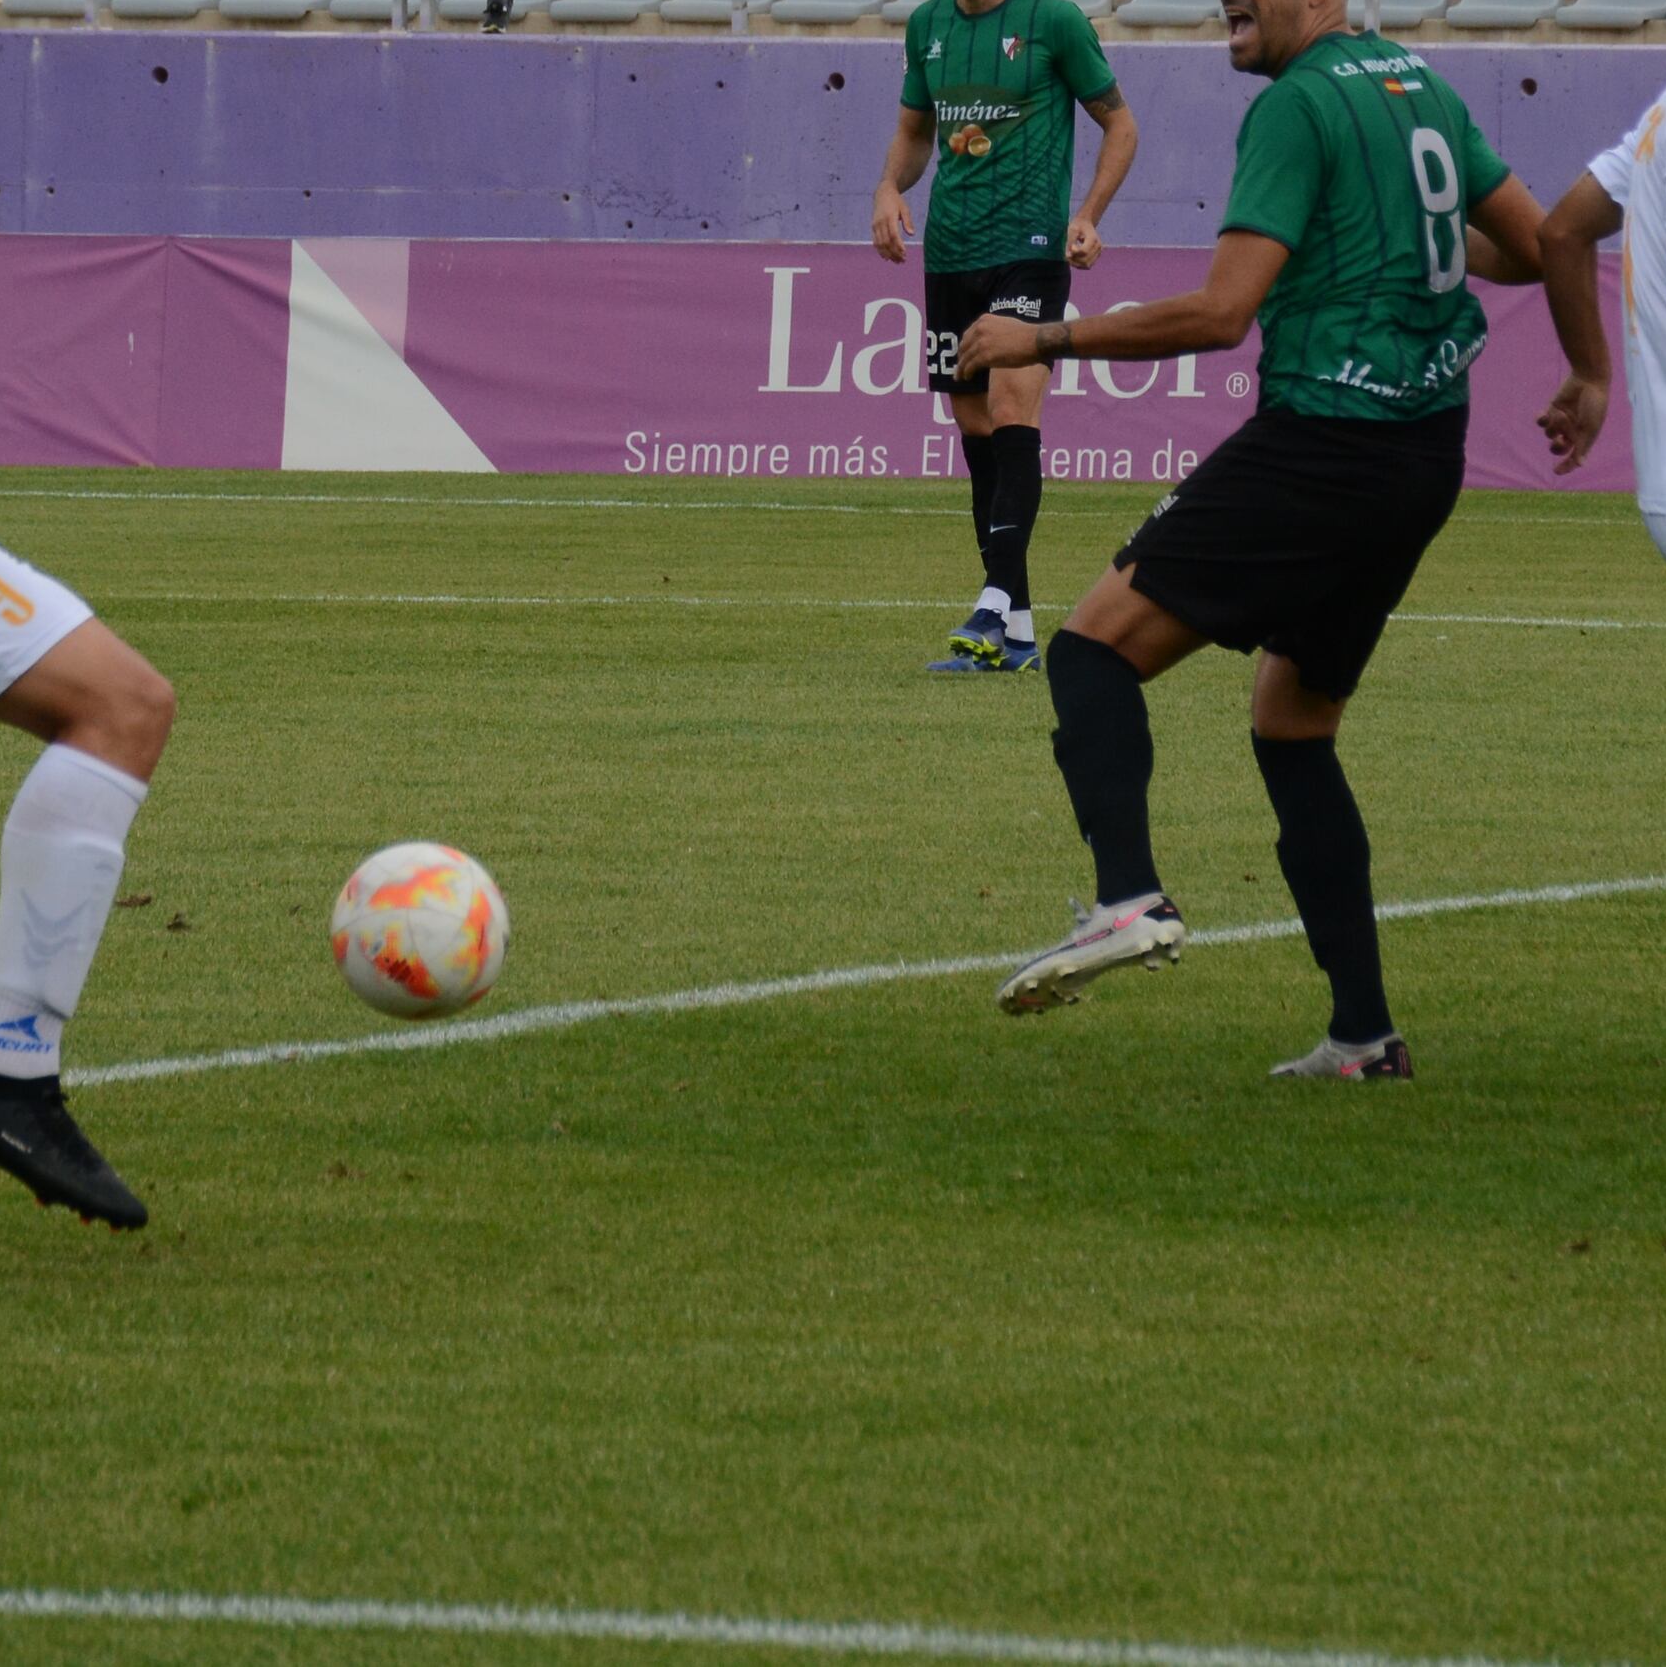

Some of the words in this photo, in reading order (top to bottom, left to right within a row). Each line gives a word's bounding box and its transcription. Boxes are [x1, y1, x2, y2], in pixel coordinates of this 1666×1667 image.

[934, 99, 1021, 123] Jiménez
[1411, 126, 1468, 295] 8
[925, 329, 960, 376] 22
[623, 431, 790, 477] Siempre
[808, 436, 900, 475] más.
[923, 434, 954, 475] El
[1152, 438, 1198, 481] de
